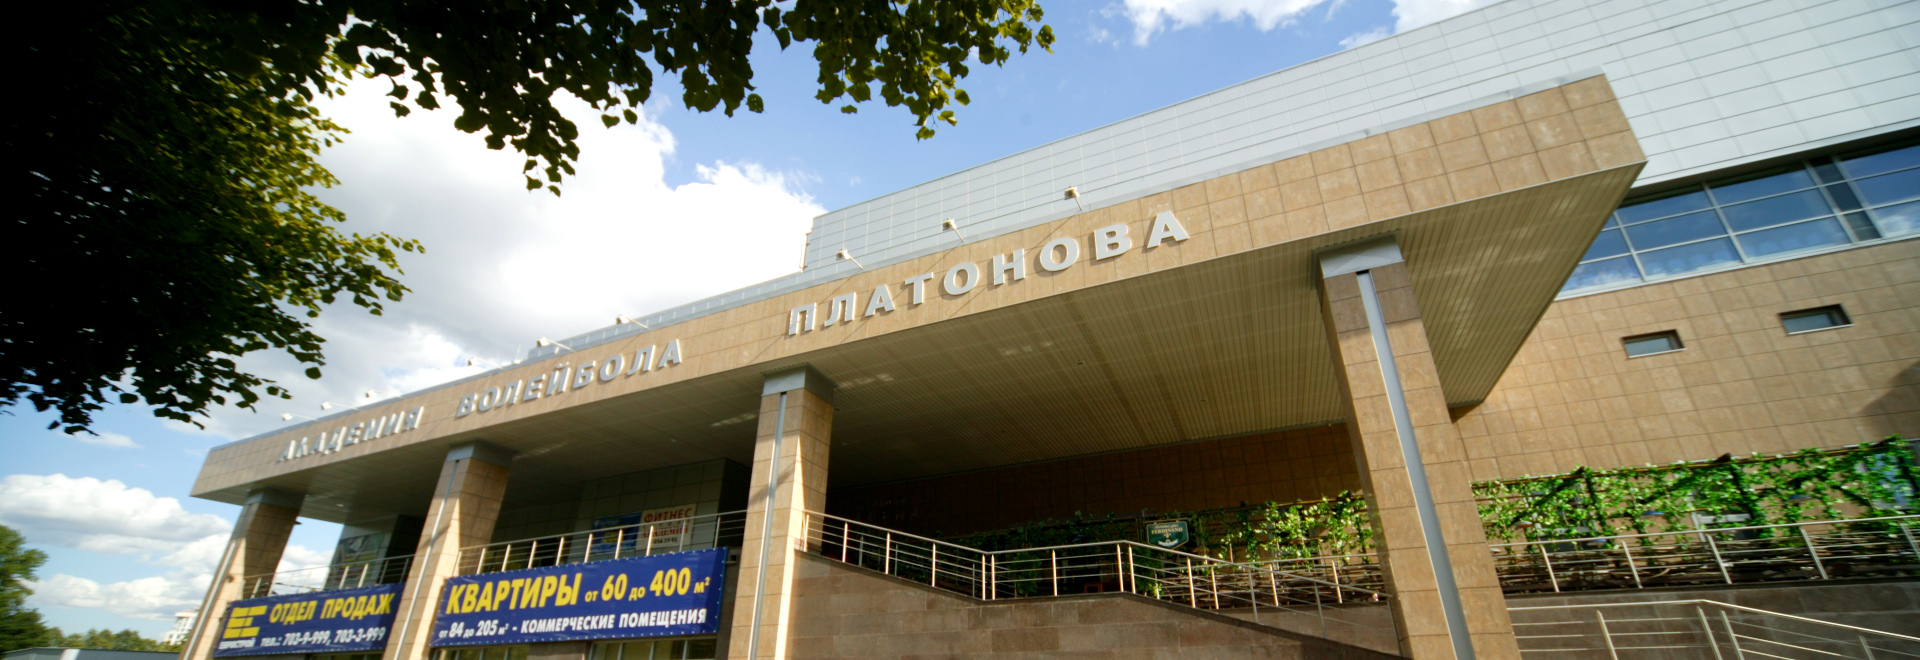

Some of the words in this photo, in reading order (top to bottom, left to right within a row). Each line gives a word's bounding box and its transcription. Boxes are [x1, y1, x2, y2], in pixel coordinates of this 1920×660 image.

[278, 406, 425, 462] АКАДЕМИЯ
[456, 338, 683, 418] ВОЛЕЙБОЛА
[788, 210, 1190, 336] ПЛАТОНОВА
[644, 509, 691, 522] ФИТНЕС
[445, 573, 582, 615] КВАРТИРЫ
[601, 573, 628, 601] 60
[628, 586, 646, 601] до
[649, 567, 691, 597] 400
[269, 601, 318, 626] ОТДЕЛ
[320, 593, 396, 621] ПРОДАЖ
[448, 621, 464, 638] 84
[475, 619, 499, 637] 205
[520, 614, 616, 634] КОММЕРЧЕСКИЕ
[618, 608, 707, 628] ПОМЕЩЕНИЯ
[333, 627, 386, 643] 703-3-999
